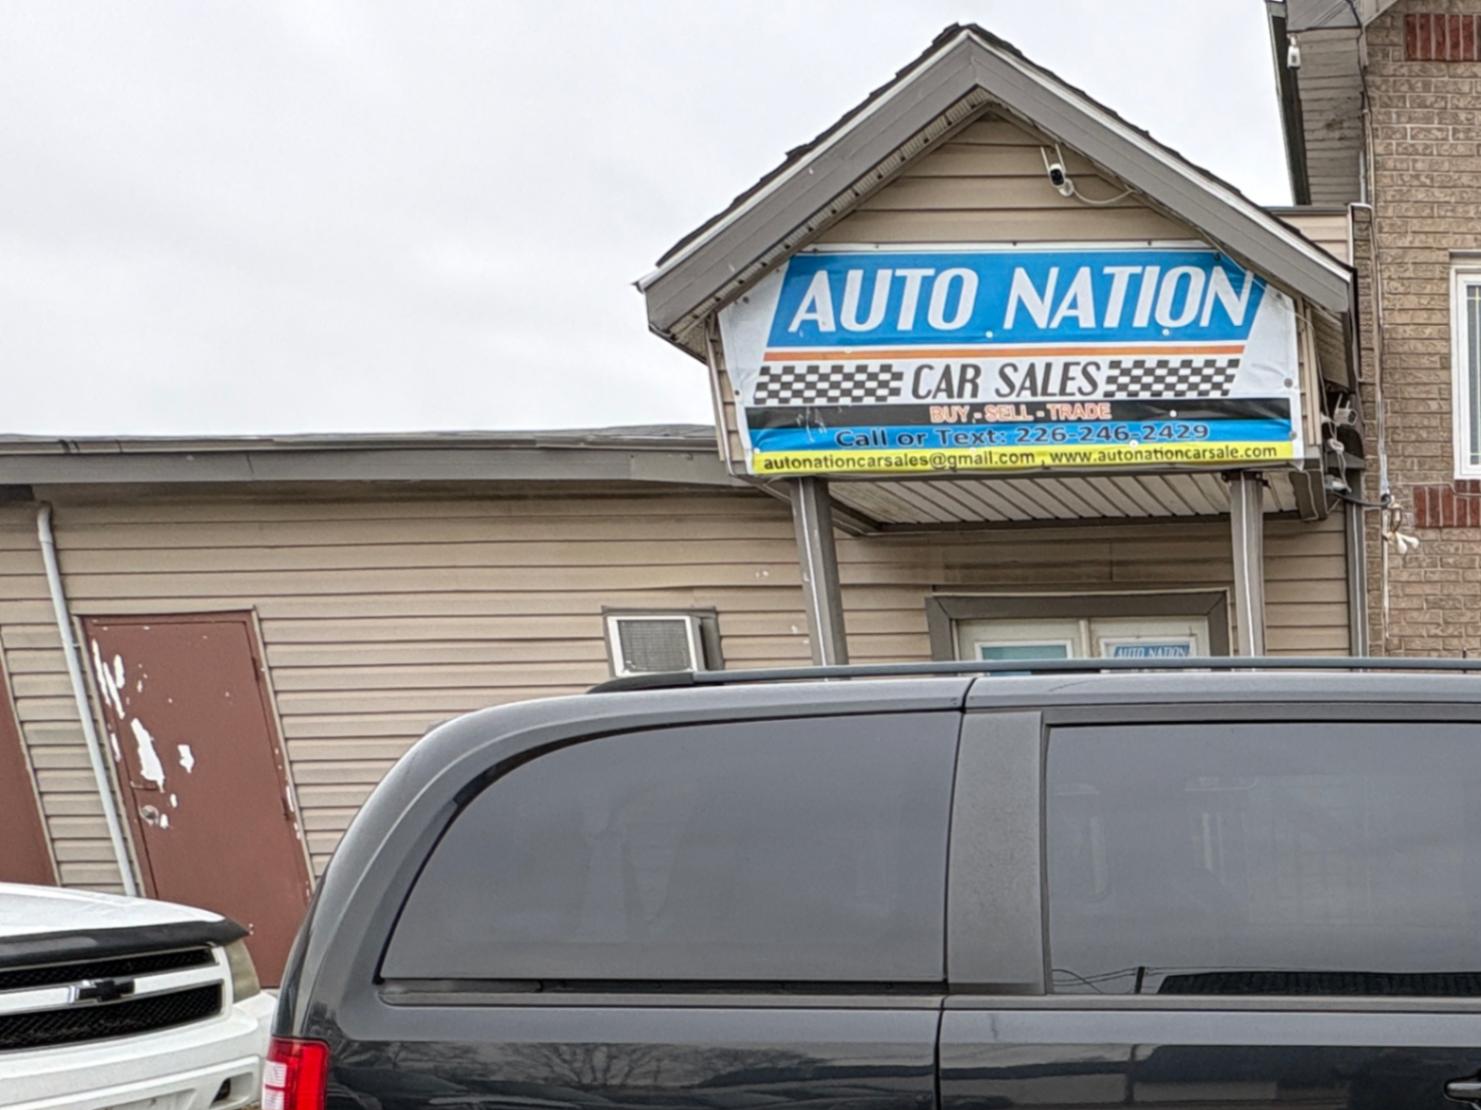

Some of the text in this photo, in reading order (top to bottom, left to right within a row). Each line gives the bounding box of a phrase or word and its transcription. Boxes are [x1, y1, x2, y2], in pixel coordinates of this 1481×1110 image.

[788, 265, 1255, 333] AUTO NATION
[911, 361, 1100, 399] CAR SALES
[929, 405, 970, 423] BUY
[984, 404, 1034, 422] SELL
[1047, 402, 1111, 421] TRADE
[835, 424, 1209, 448] Call or Text: 226-246-2429
[764, 443, 1277, 471] autonationcarsales@gmail.com www.autonationcarsale.com
